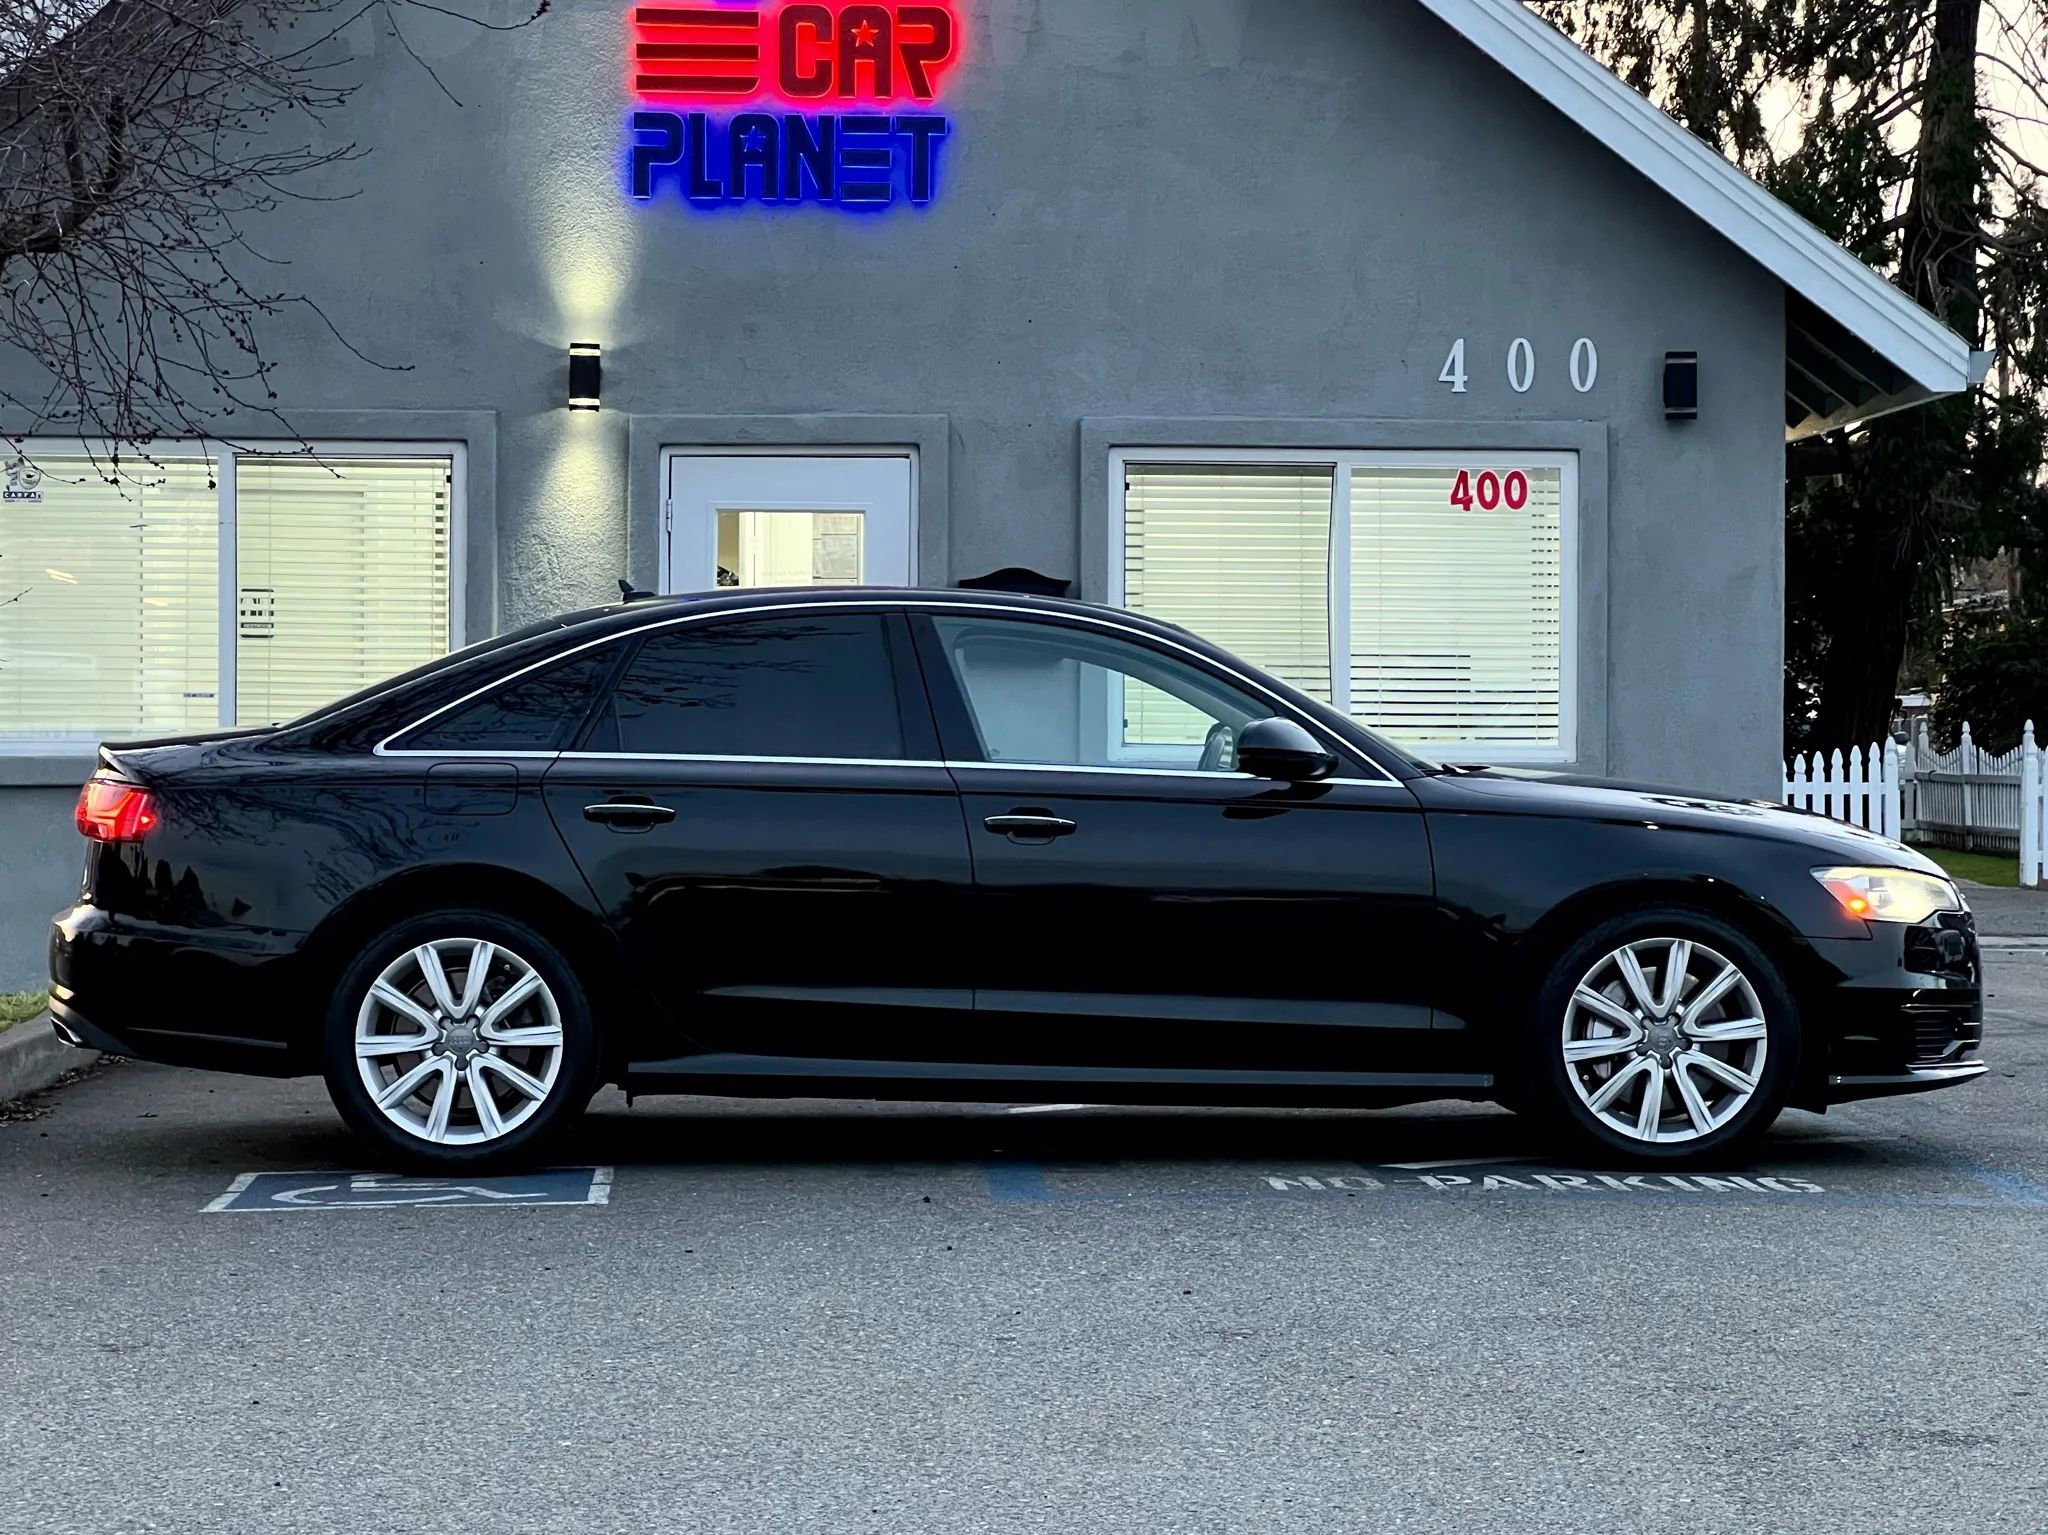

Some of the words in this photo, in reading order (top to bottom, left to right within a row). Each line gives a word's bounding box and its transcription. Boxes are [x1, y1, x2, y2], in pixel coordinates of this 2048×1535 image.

[778, 4, 952, 98] CAR
[632, 111, 947, 202] PLANET
[1449, 468, 1529, 512] 400
[1258, 1175, 1386, 1191] NO
[1416, 1174, 1827, 1193] PARKING
